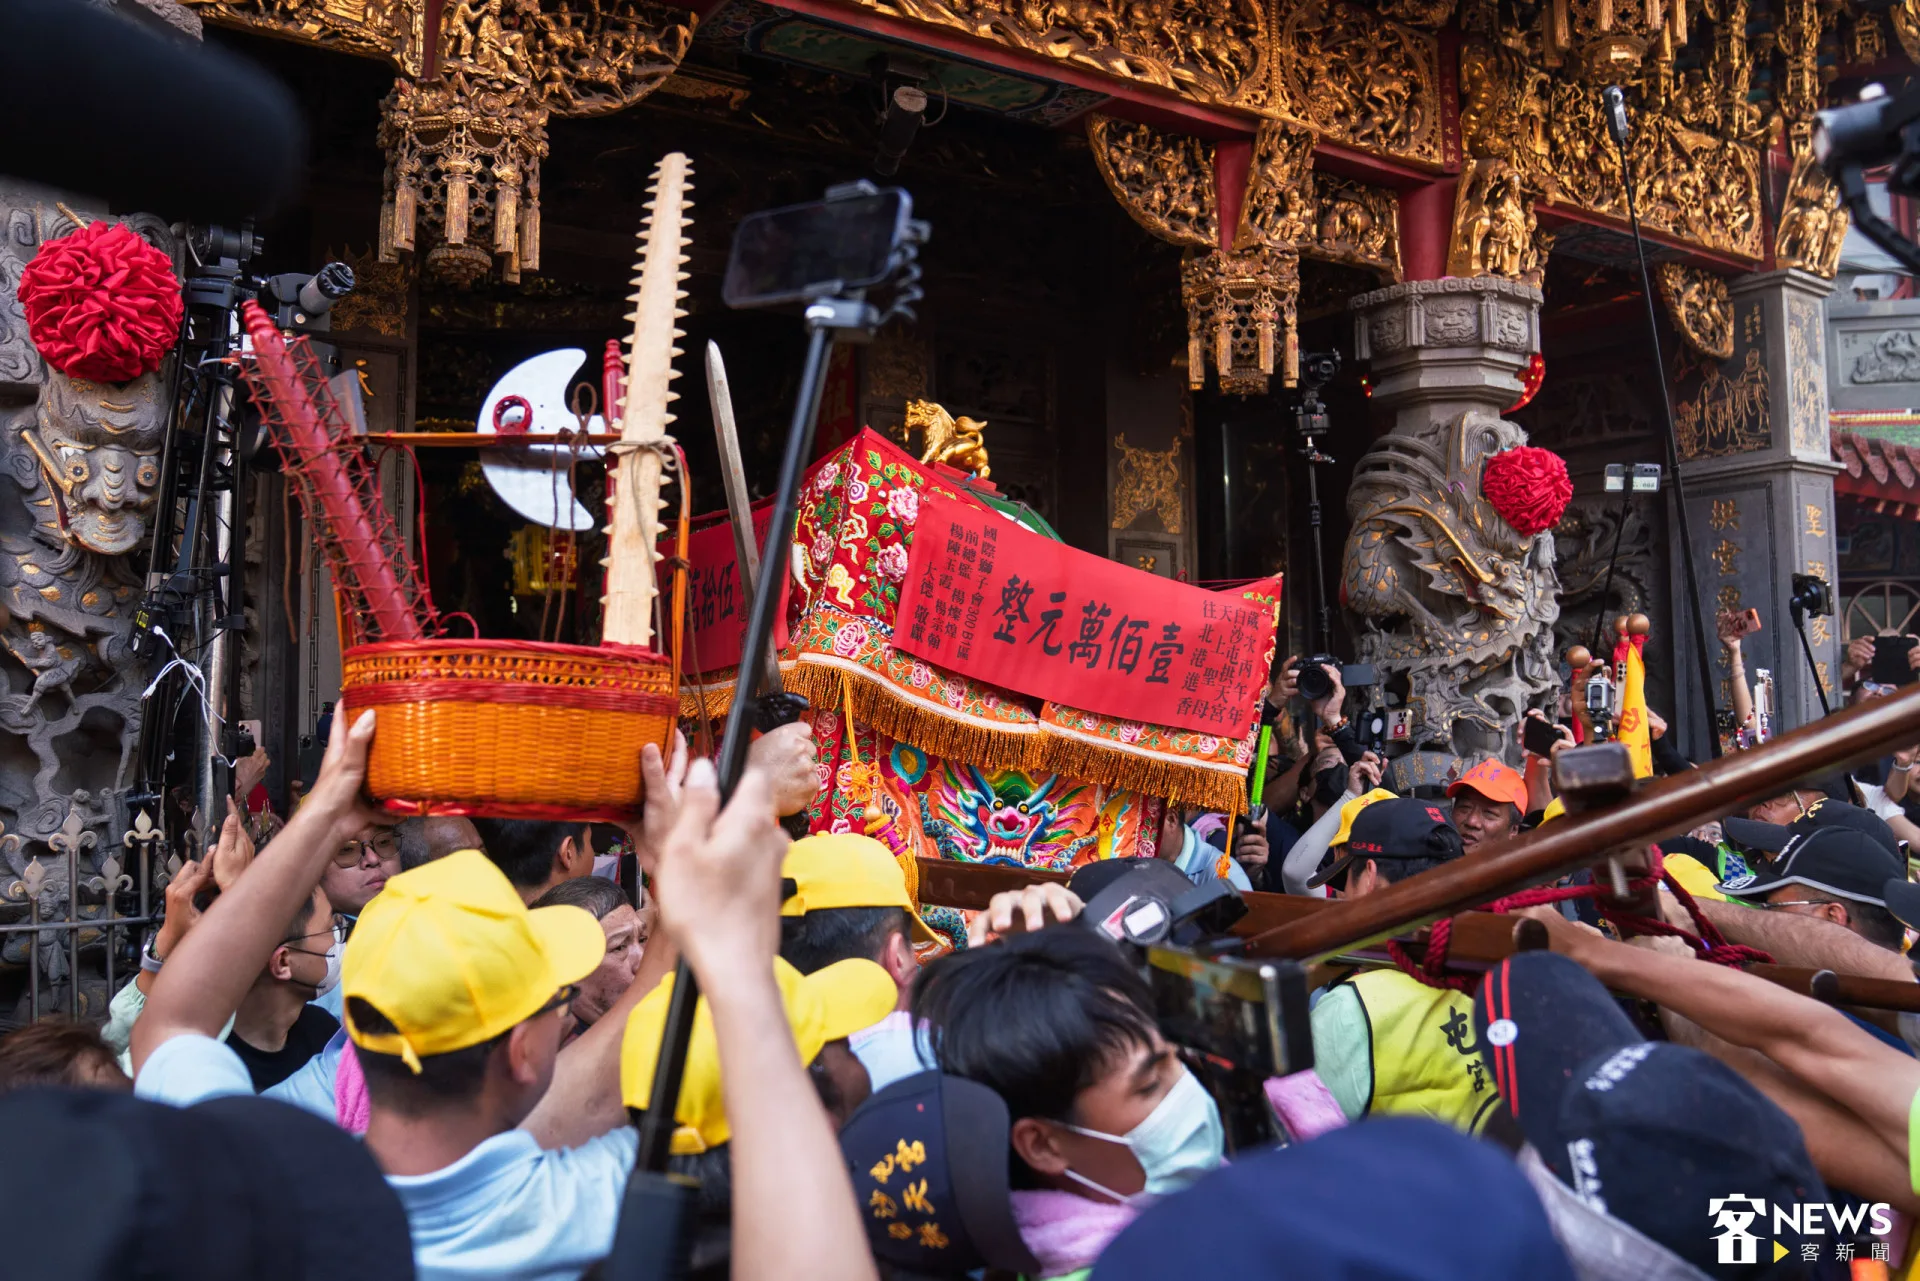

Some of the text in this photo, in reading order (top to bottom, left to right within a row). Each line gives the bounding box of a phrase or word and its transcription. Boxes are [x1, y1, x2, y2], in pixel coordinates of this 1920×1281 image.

[1176, 599, 1217, 717] 往北港進香
[1191, 604, 1233, 719] 天上聖母
[1209, 607, 1246, 724] 白沙屯拱天宮
[1227, 610, 1259, 727] 歲次丙午年
